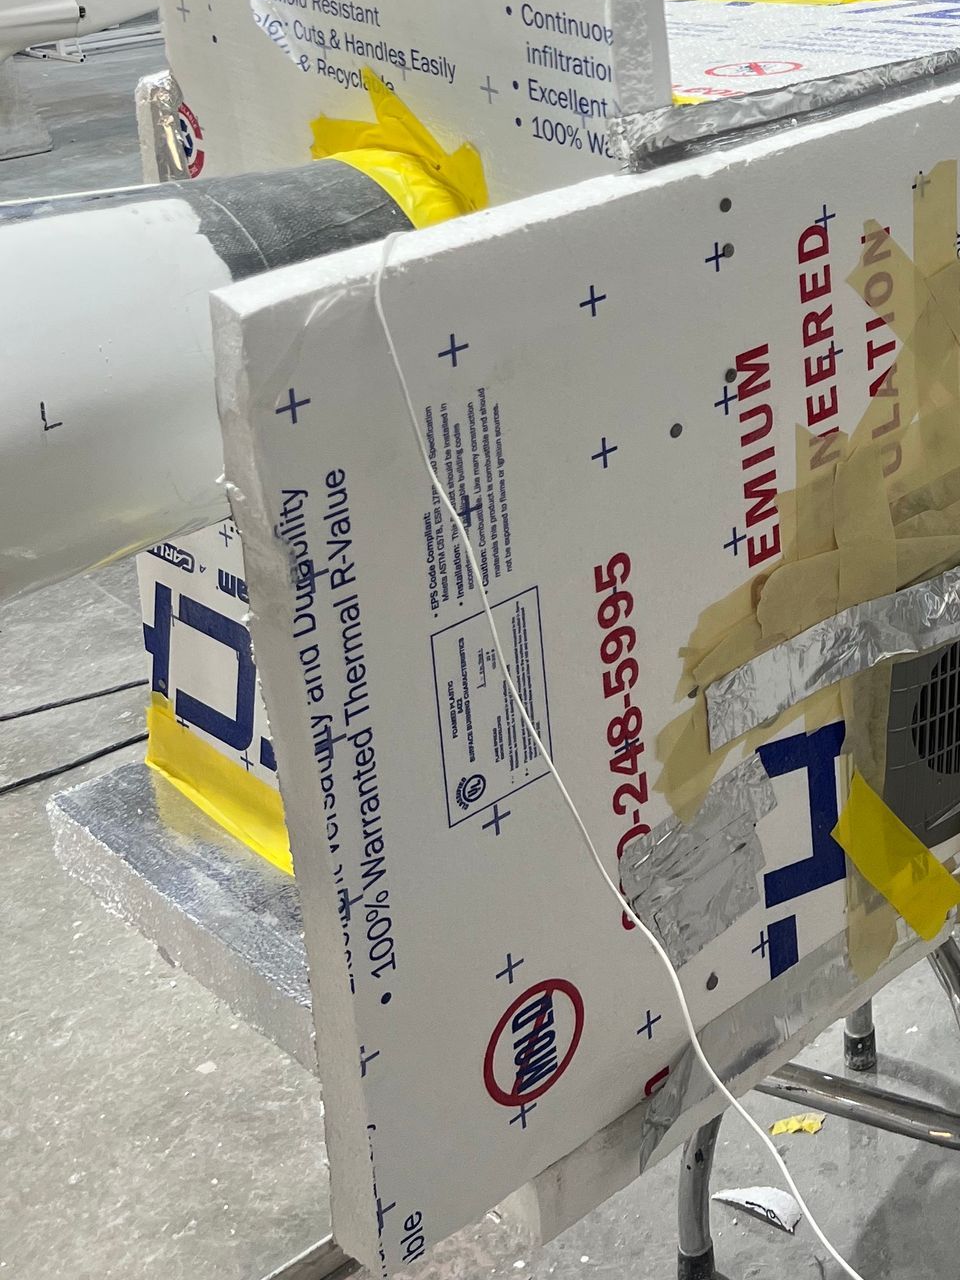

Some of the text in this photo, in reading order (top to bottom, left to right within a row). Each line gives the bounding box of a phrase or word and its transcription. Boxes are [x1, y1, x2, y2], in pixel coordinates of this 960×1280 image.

[293, 20, 325, 47] Cuts
[330, 29, 341, 50] &
[345, 31, 407, 68] Handles
[410, 49, 456, 84] Easily
[528, 78, 608, 118] Excellent
[532, 116, 583, 150] 100%
[478, 388, 486, 415] should
[425, 405, 436, 459] Specification
[441, 412, 451, 448] installed
[467, 402, 477, 452] construction
[445, 449, 452, 460] be
[456, 449, 464, 481] building
[471, 453, 479, 475] many
[482, 434, 492, 483] combustible
[495, 438, 503, 467] ignition
[734, 342, 781, 569] EMIUM
[446, 461, 454, 489] should
[473, 477, 481, 494] Like
[487, 492, 496, 523] product
[502, 513, 510, 545] exposed
[423, 511, 439, 610] EPS Code Compliant:
[438, 552, 446, 575] ASTM
[479, 549, 489, 587] Caution:
[492, 541, 501, 577] materials
[505, 547, 511, 557] be
[440, 576, 449, 601] Meets
[453, 544, 464, 598] Installation:
[323, 467, 397, 979] 100% Warranted Thermal R-Value
[511, 994, 558, 1095] MOLD
